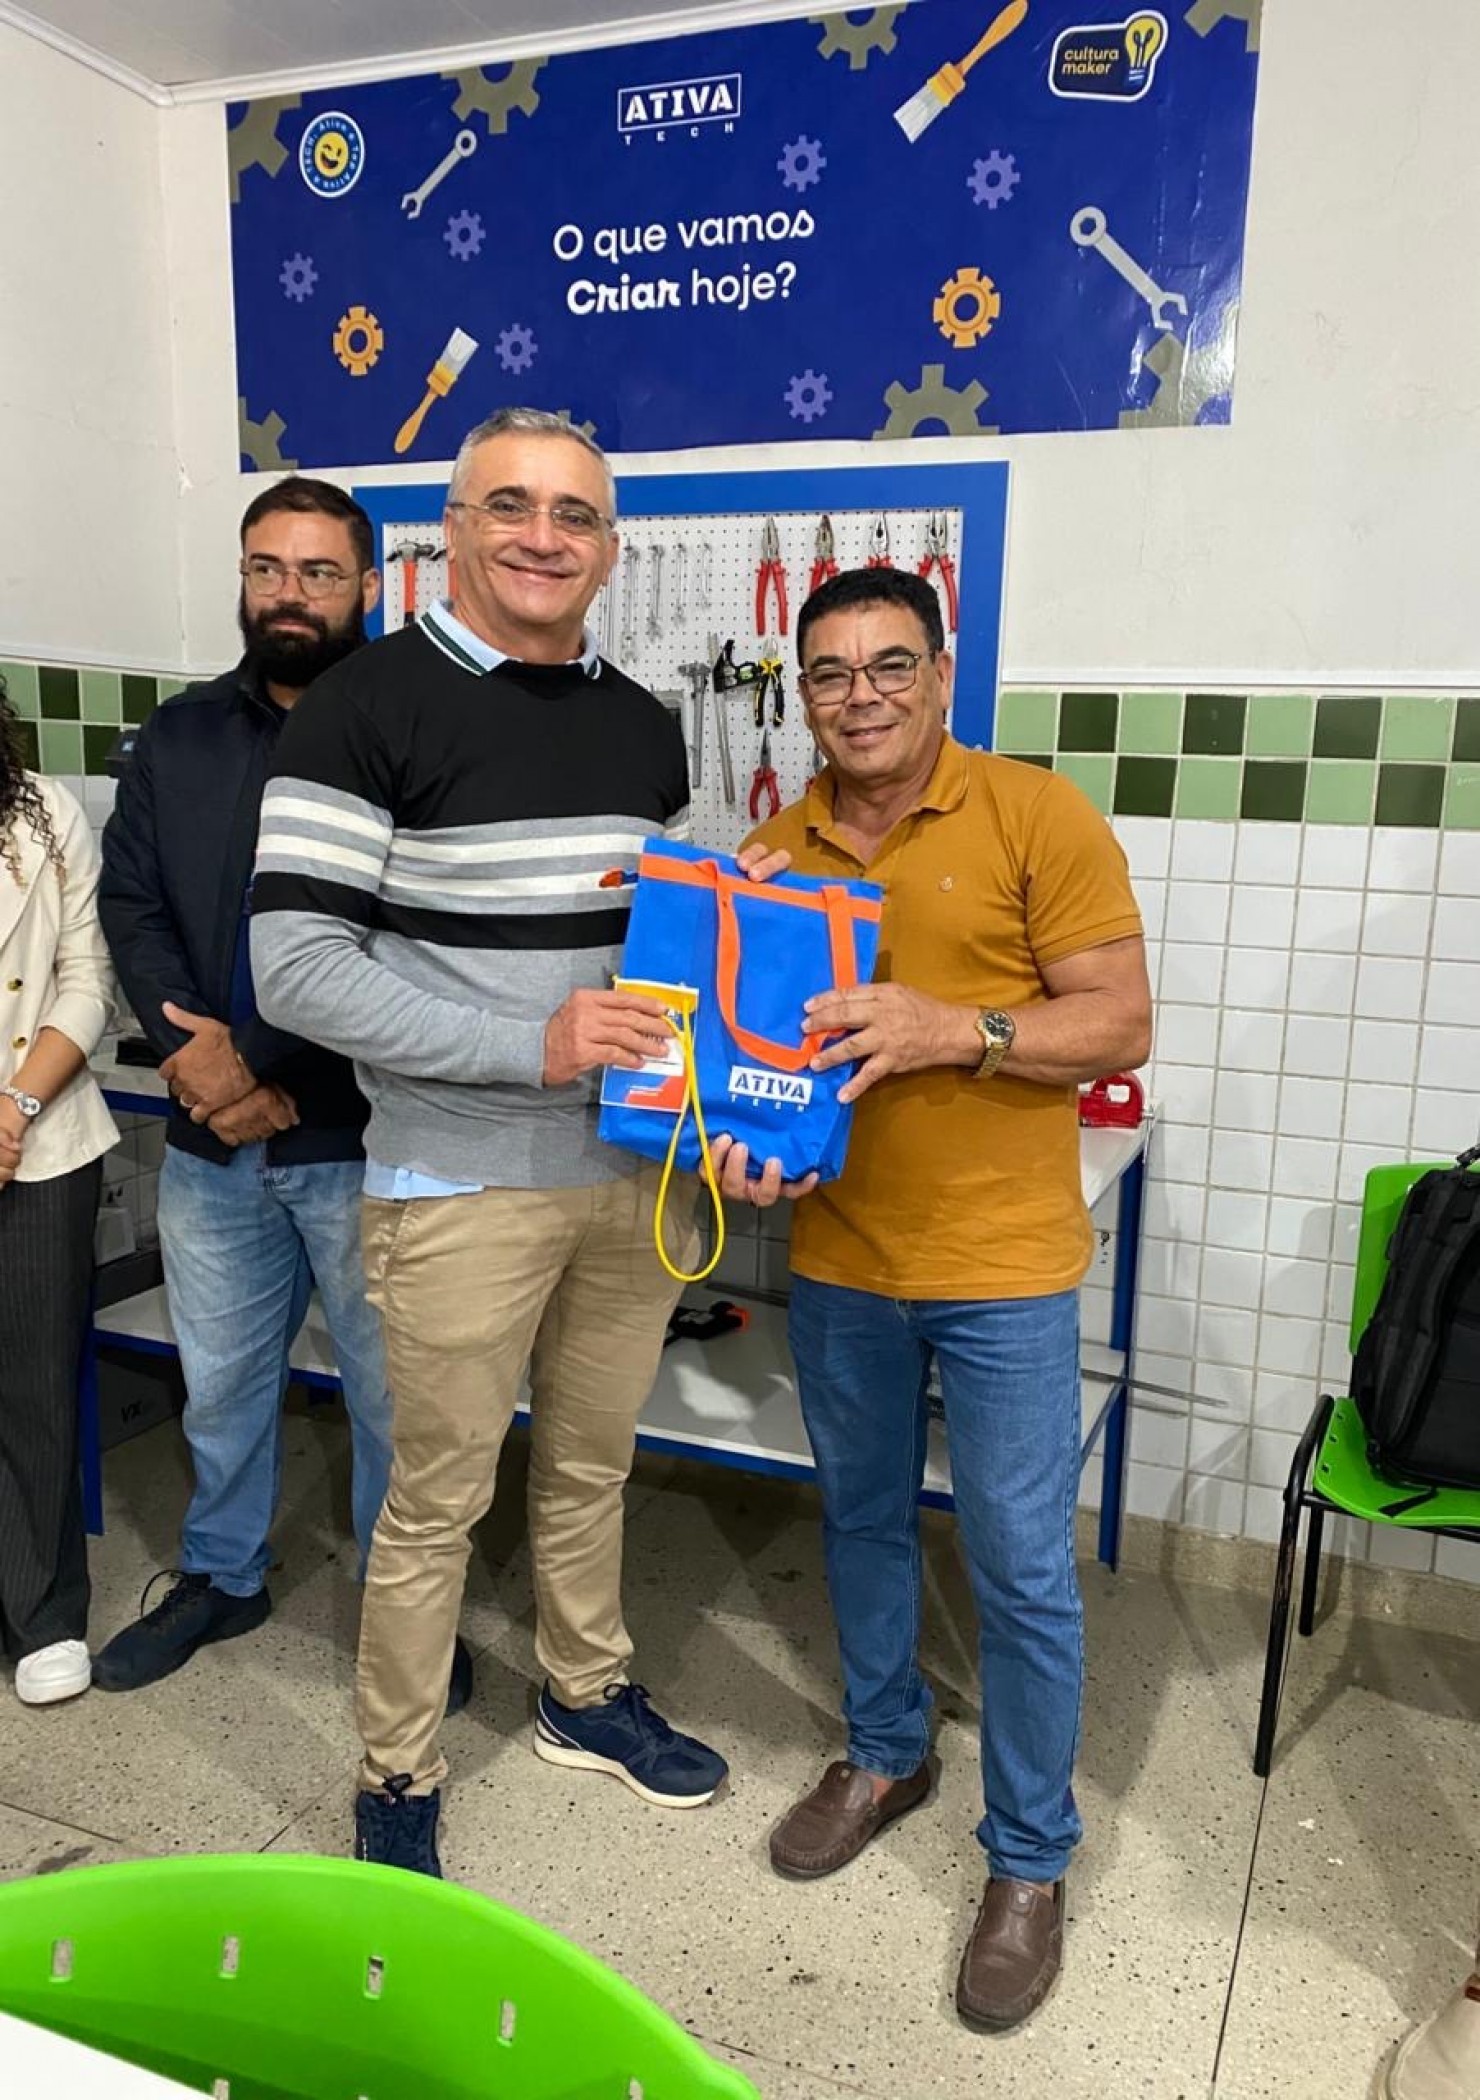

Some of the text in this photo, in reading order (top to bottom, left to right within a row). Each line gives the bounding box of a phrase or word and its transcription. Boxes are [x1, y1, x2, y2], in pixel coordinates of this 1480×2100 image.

[1062, 60, 1111, 74] maker
[1064, 46, 1119, 60] cultura
[625, 83, 734, 123] ATIVA
[553, 209, 815, 264] O que vamos
[567, 261, 797, 315] Criar hoje?
[734, 1072, 805, 1100] ATIVA
